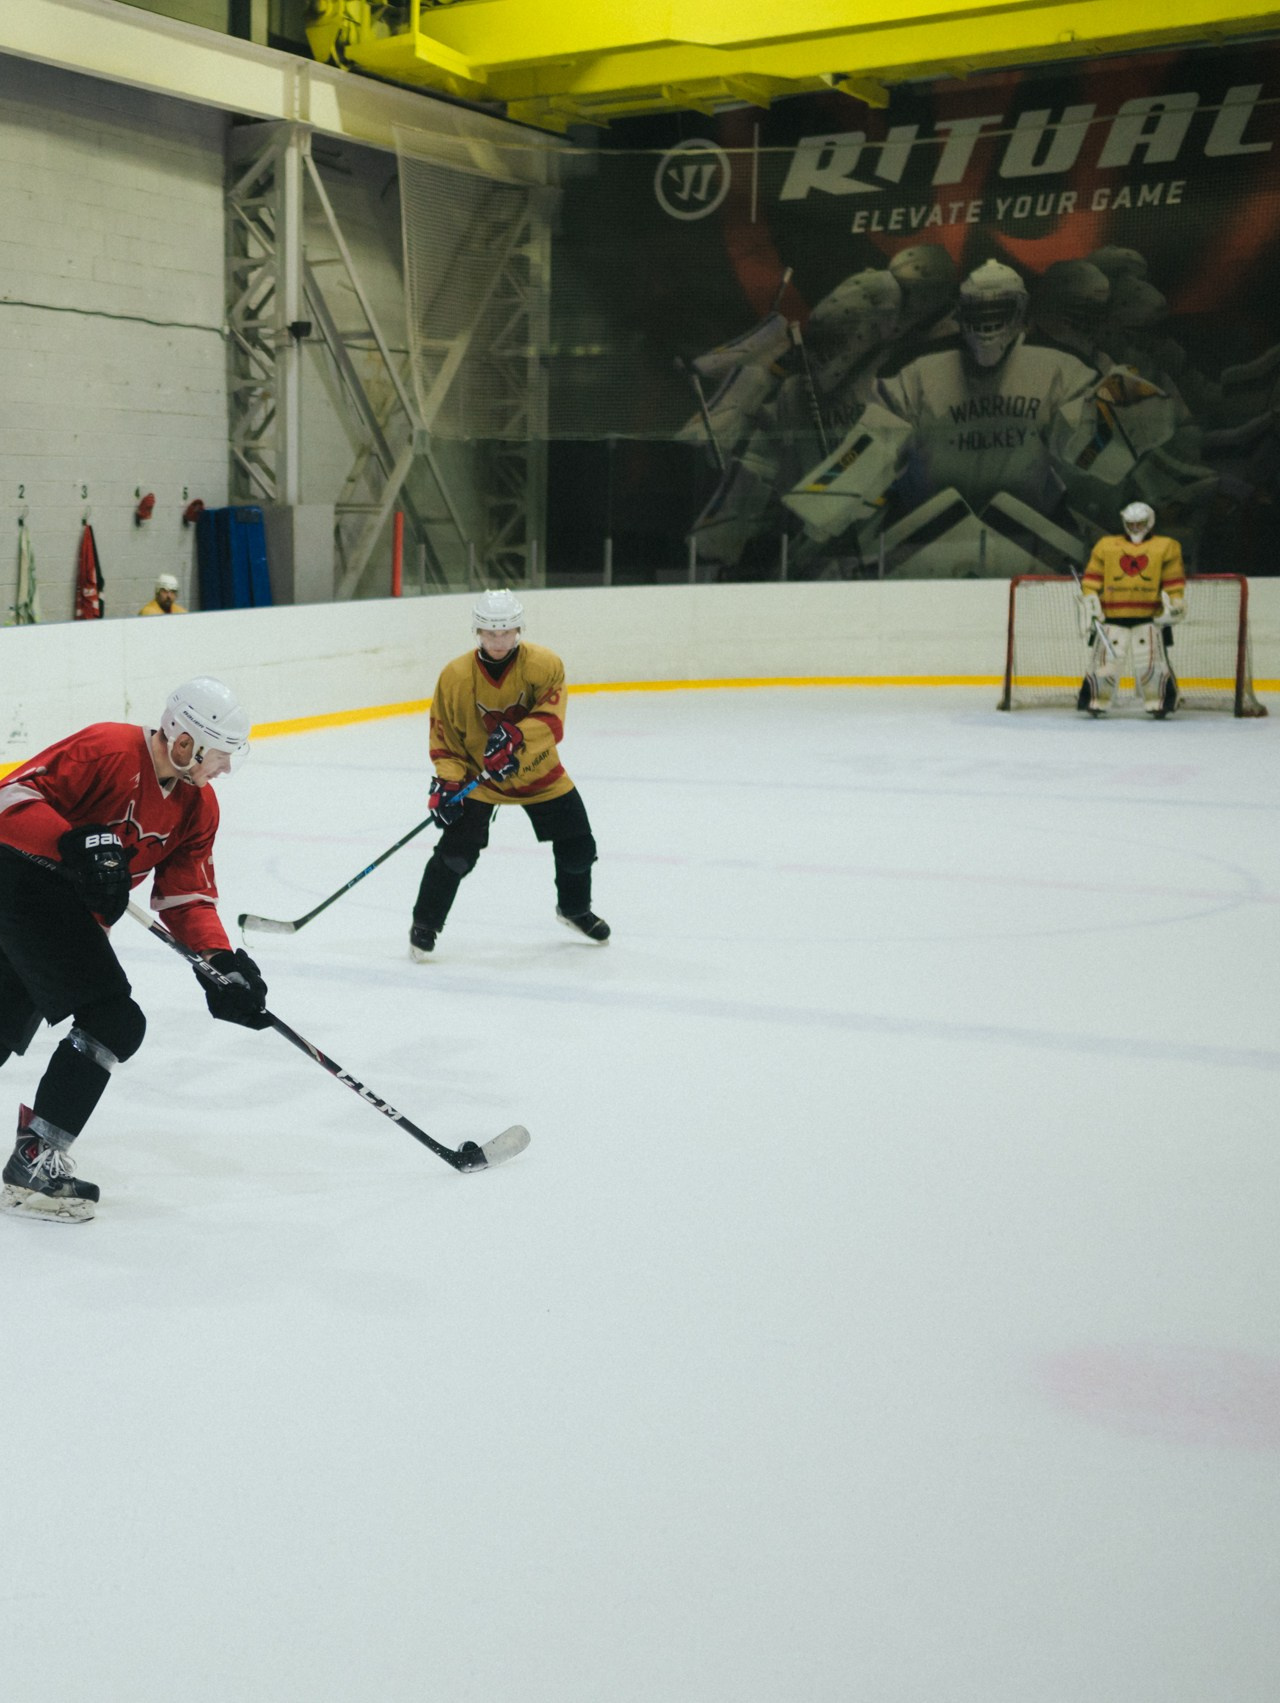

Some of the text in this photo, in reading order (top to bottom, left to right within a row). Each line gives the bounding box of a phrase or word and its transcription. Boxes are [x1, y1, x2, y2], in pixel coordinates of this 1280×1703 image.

[779, 84, 1273, 200] RITUAL
[851, 180, 1187, 234] ELEVATE YOUR GAME
[948, 395, 1041, 424] WARRIOR
[958, 427, 1026, 450] HOCKEY
[18, 485, 25, 499] 2
[81, 486, 88, 499] 3
[188, 954, 232, 985] JETS
[336, 1069, 403, 1121] CCM
